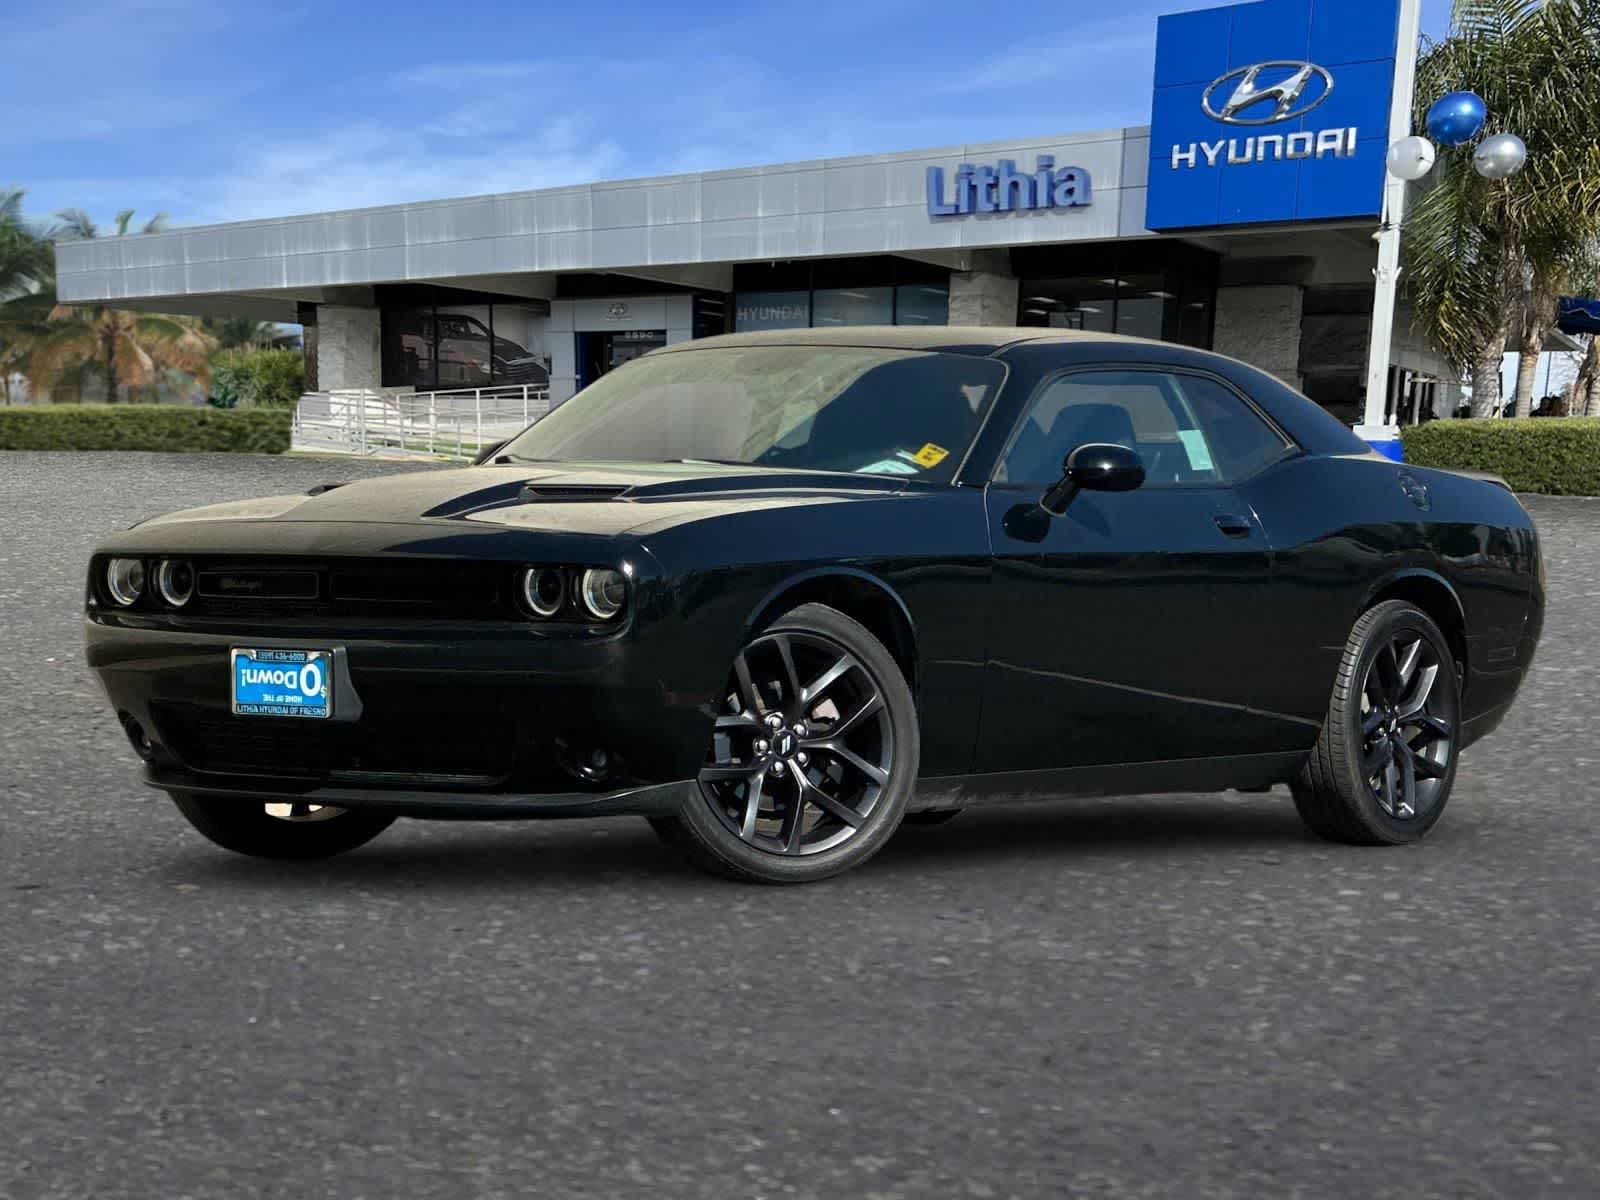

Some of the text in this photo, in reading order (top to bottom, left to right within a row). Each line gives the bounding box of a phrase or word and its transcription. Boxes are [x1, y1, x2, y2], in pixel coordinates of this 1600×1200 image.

[1171, 127, 1356, 169] HYUNDAI
[926, 154, 1092, 219] Lithia
[737, 305, 809, 321] HYUNDAI
[241, 668, 298, 689] Down!
[236, 704, 259, 713] LITHIA
[259, 705, 289, 715] HYUNDAI
[289, 706, 299, 715] OF
